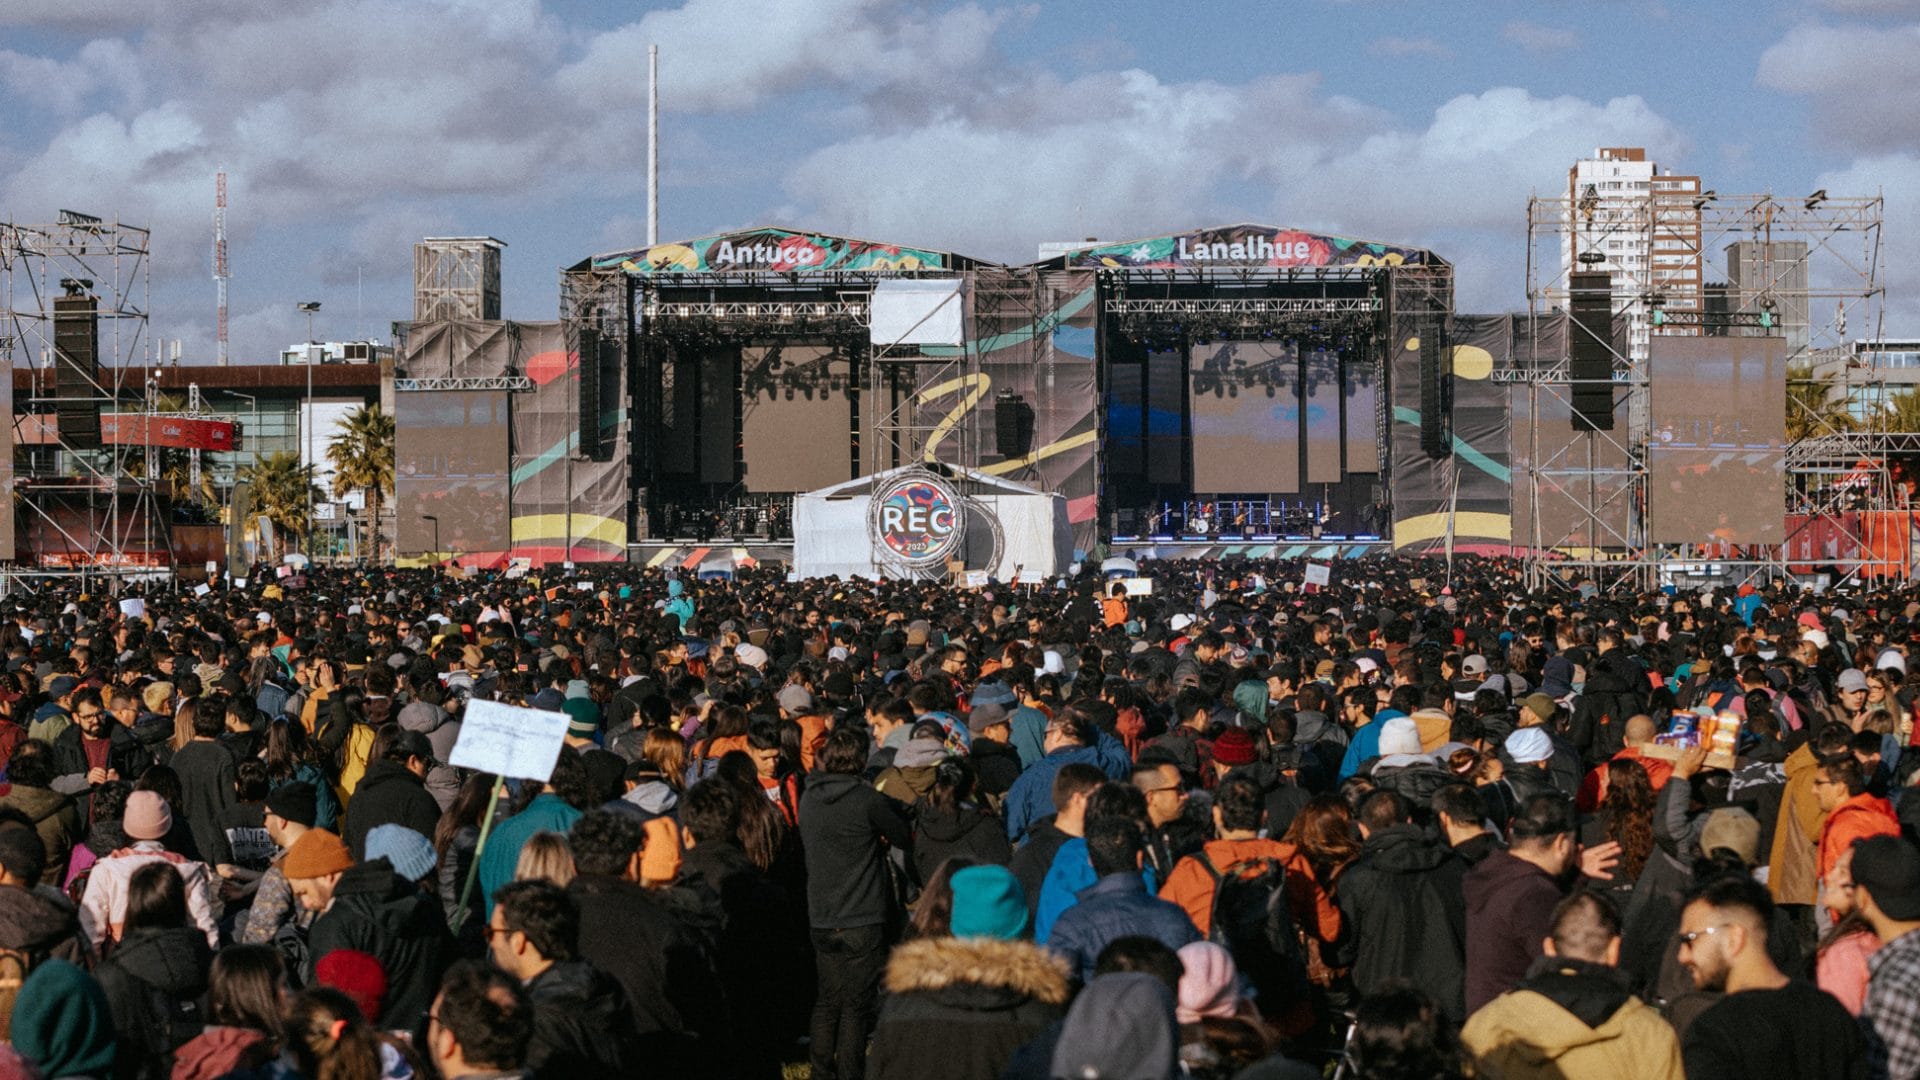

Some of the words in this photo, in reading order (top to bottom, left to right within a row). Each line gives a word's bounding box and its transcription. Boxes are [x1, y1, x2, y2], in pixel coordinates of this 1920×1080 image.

[716, 241, 814, 263] Antuco
[1179, 236, 1311, 260] Lanalhue
[162, 424, 181, 435] Coke
[883, 507, 954, 534] REC
